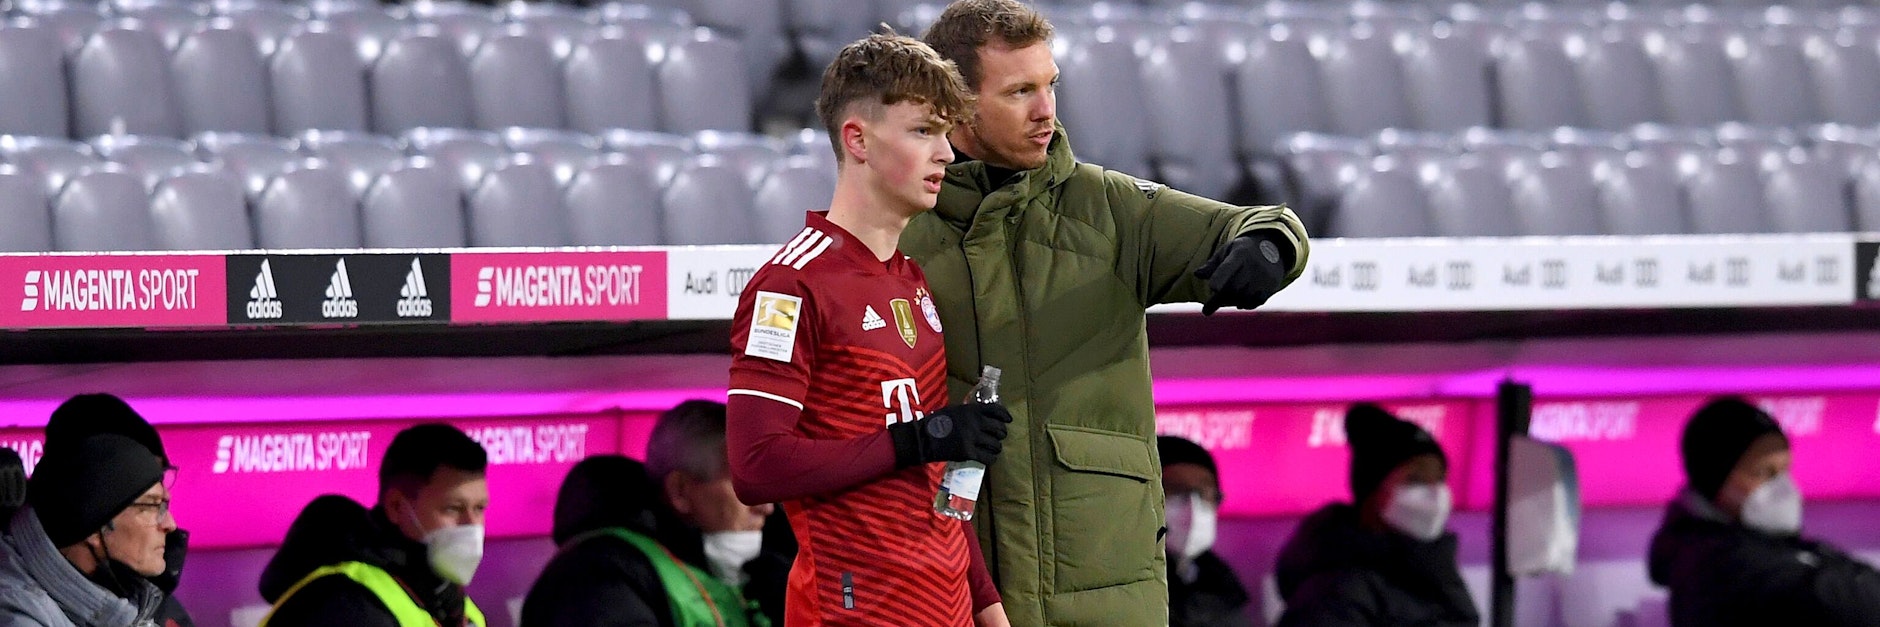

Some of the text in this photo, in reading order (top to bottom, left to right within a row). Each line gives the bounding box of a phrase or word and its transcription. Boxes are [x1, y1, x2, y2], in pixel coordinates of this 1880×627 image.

[496, 265, 643, 307] MAGENTA SPORT
[684, 270, 718, 294] Audi
[1311, 264, 1343, 288] Audi
[1406, 264, 1438, 288] Audi
[44, 269, 199, 311] MAGENTA SPORT
[246, 298, 283, 318] adidas
[322, 298, 358, 318] adidas
[397, 297, 433, 317] adidas
[754, 328, 791, 338] BUNDESLIGA
[862, 318, 887, 331] adidas
[232, 431, 372, 473] MAGENTA SPORT
[536, 424, 588, 463] SPORT
